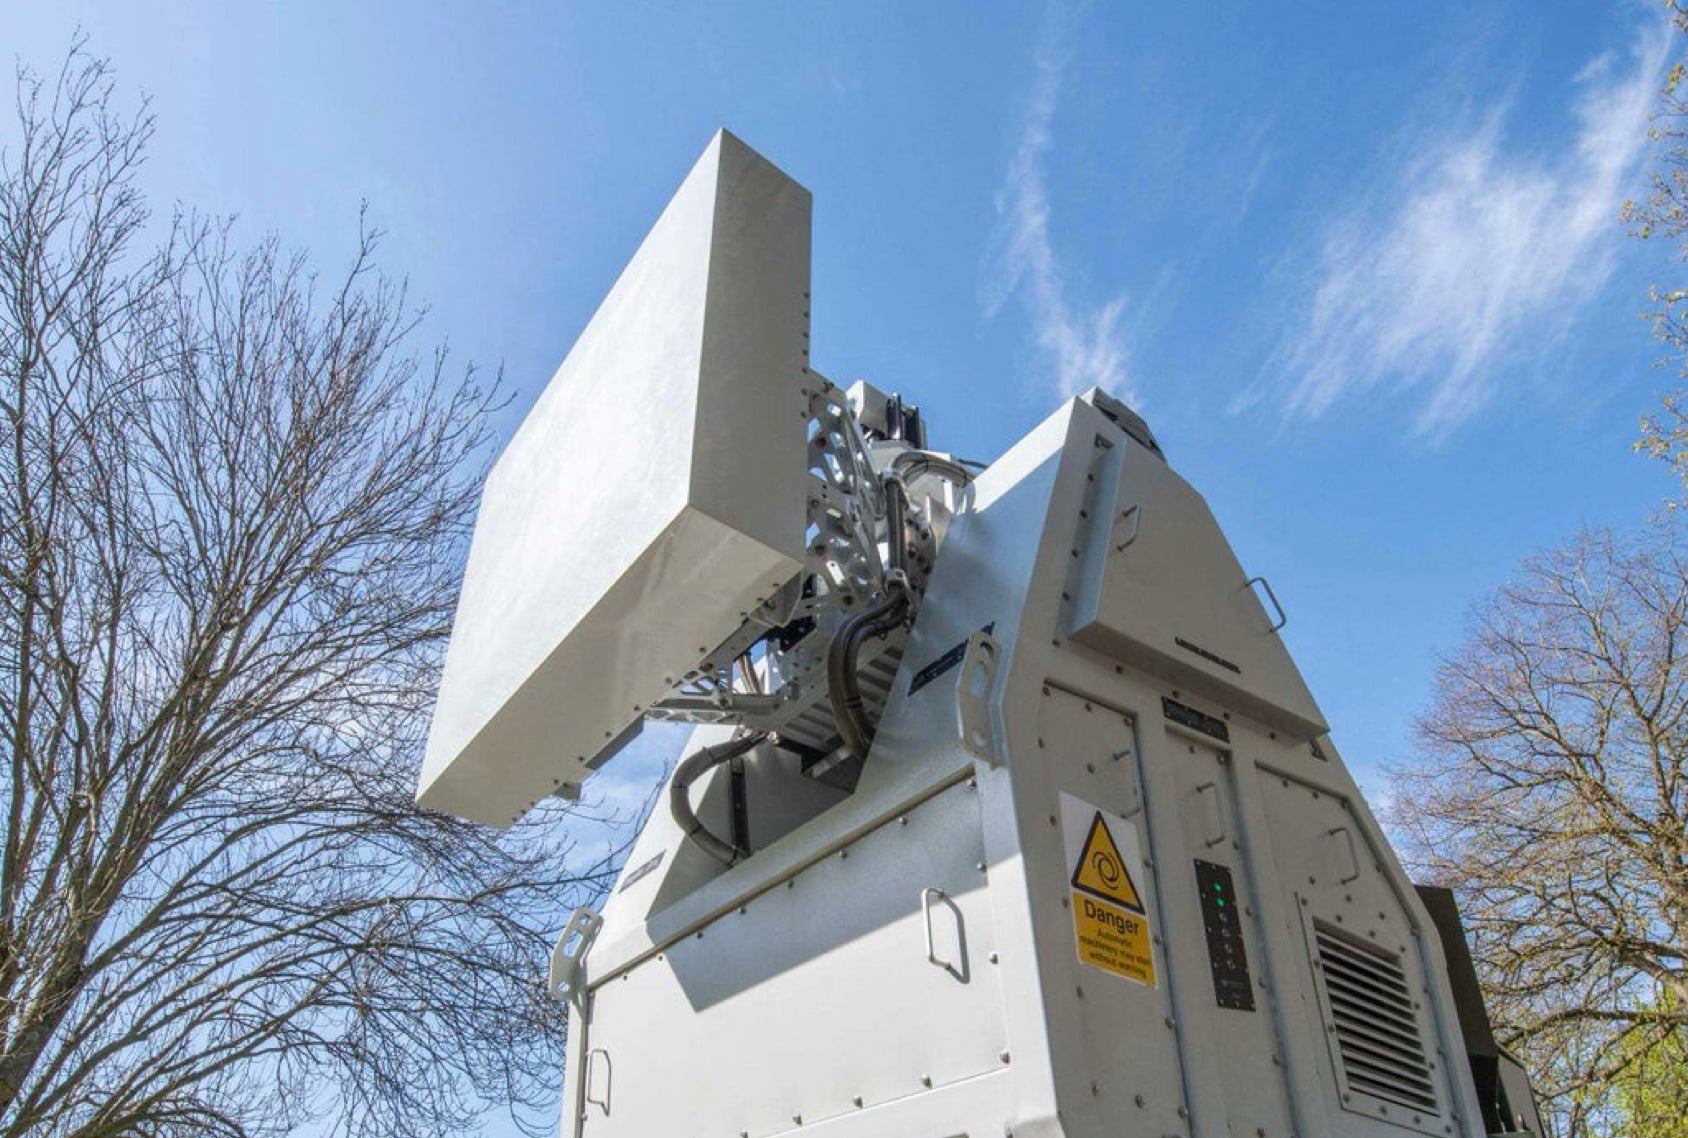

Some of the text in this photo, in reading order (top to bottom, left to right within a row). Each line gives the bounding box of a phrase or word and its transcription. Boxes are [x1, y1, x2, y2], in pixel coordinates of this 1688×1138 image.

[1084, 898, 1139, 935] Danger
[1079, 935, 1118, 956] machinery
[1119, 950, 1135, 962] may
[1096, 928, 1133, 948] Automatic
[1089, 950, 1117, 966] without
